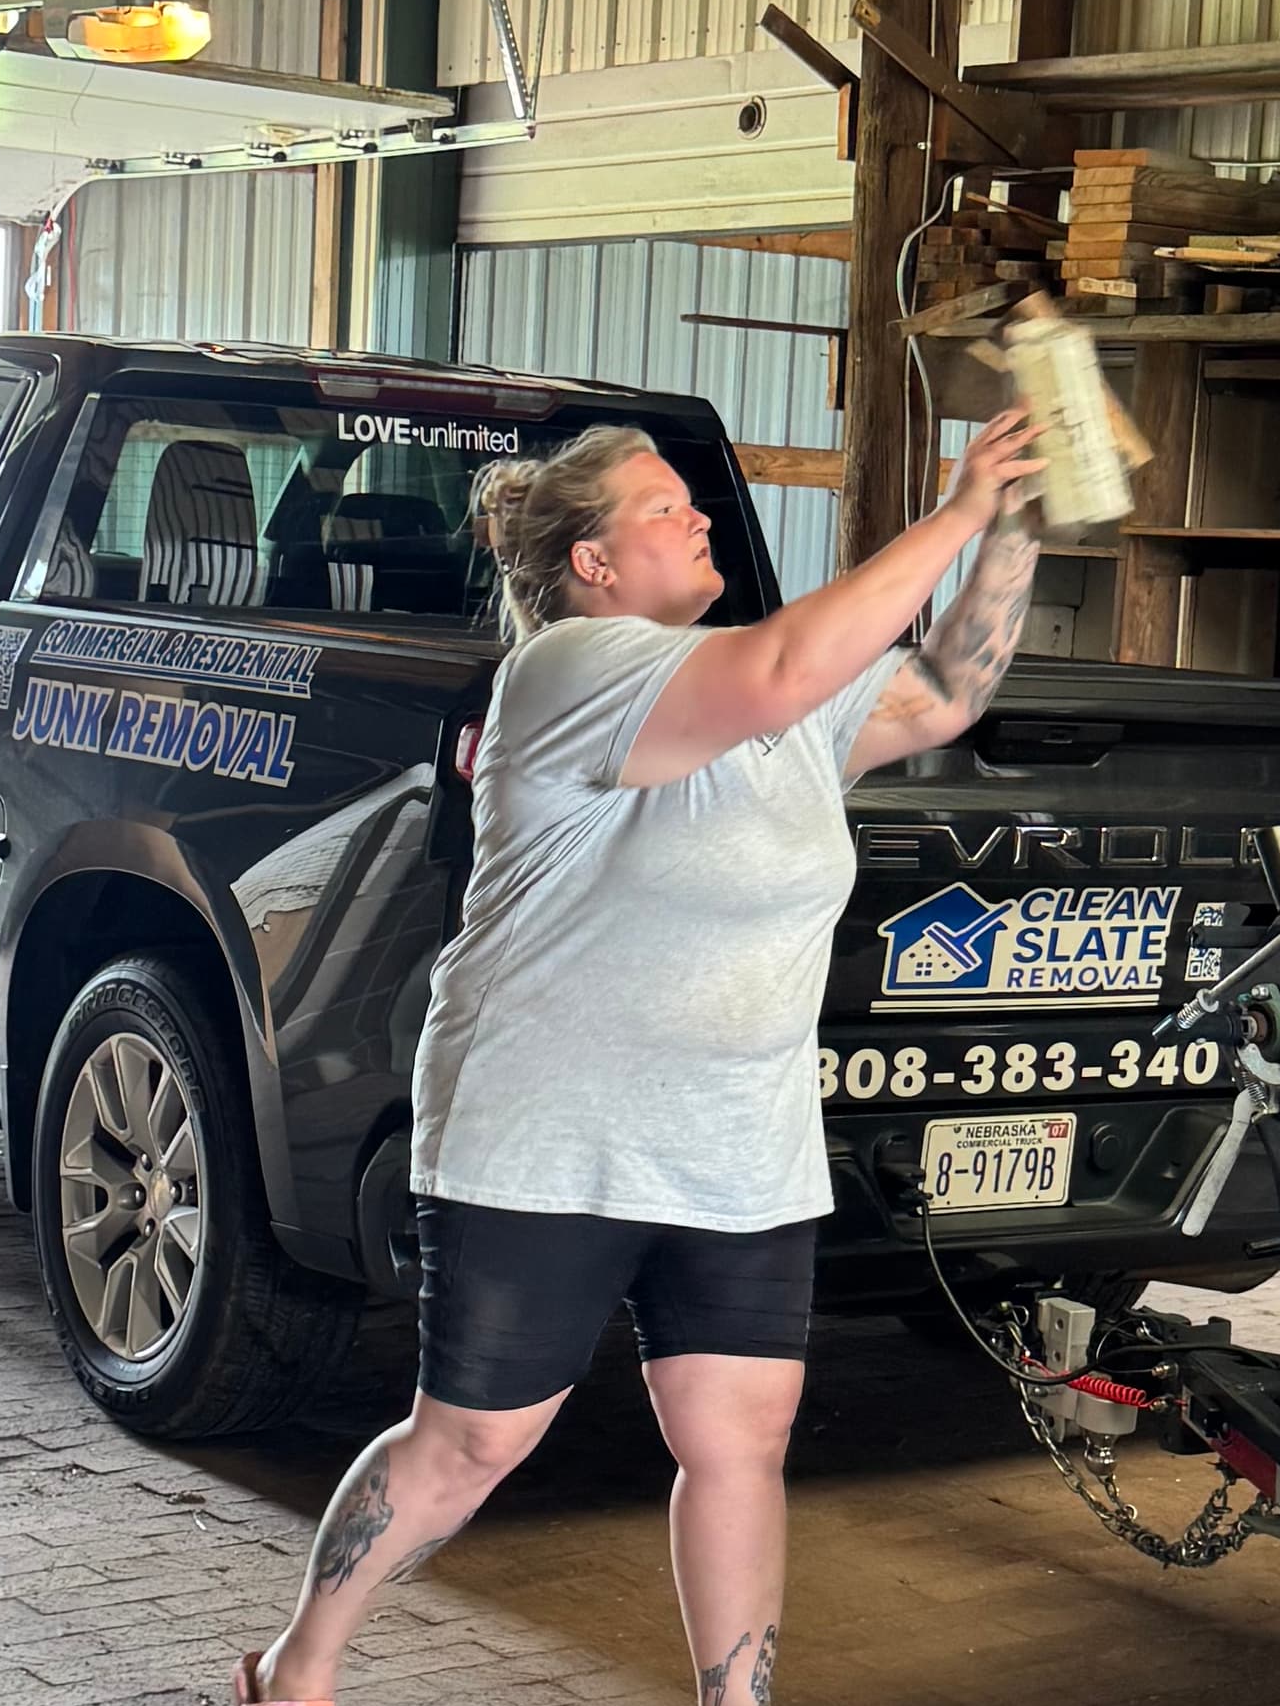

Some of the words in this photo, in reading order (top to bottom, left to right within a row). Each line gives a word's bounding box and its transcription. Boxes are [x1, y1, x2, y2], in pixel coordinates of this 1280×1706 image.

[12, 677, 114, 753] JUNK
[105, 690, 296, 787] REMOVAL
[1020, 890, 1174, 923] CLEAN
[1012, 924, 1167, 964] SLATE
[1006, 966, 1161, 989] REMOVAL
[818, 1041, 1220, 1099] 308-383-340
[956, 1139, 1012, 1149] COMMERCIAL
[1015, 1136, 1043, 1146] TRUCK
[965, 1123, 1037, 1139] NEBRASKA
[1051, 1125, 1066, 1137] 07
[935, 1146, 1057, 1197] 8-9179B
